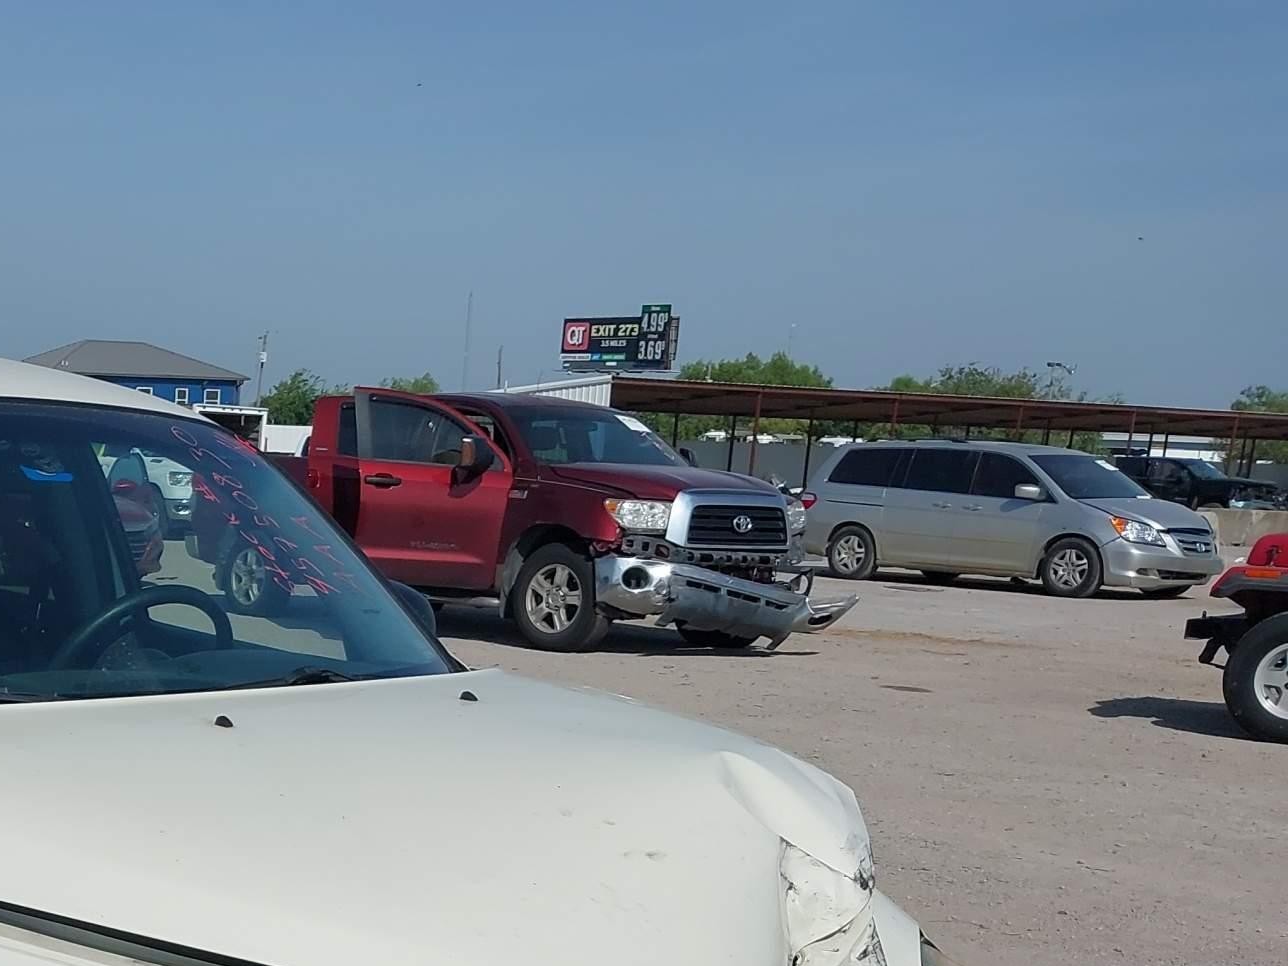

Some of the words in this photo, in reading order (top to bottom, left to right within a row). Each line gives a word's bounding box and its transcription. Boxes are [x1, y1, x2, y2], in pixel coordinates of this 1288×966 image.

[567, 326, 586, 346] QT
[591, 325, 616, 337] EXIT
[618, 324, 639, 336] 273
